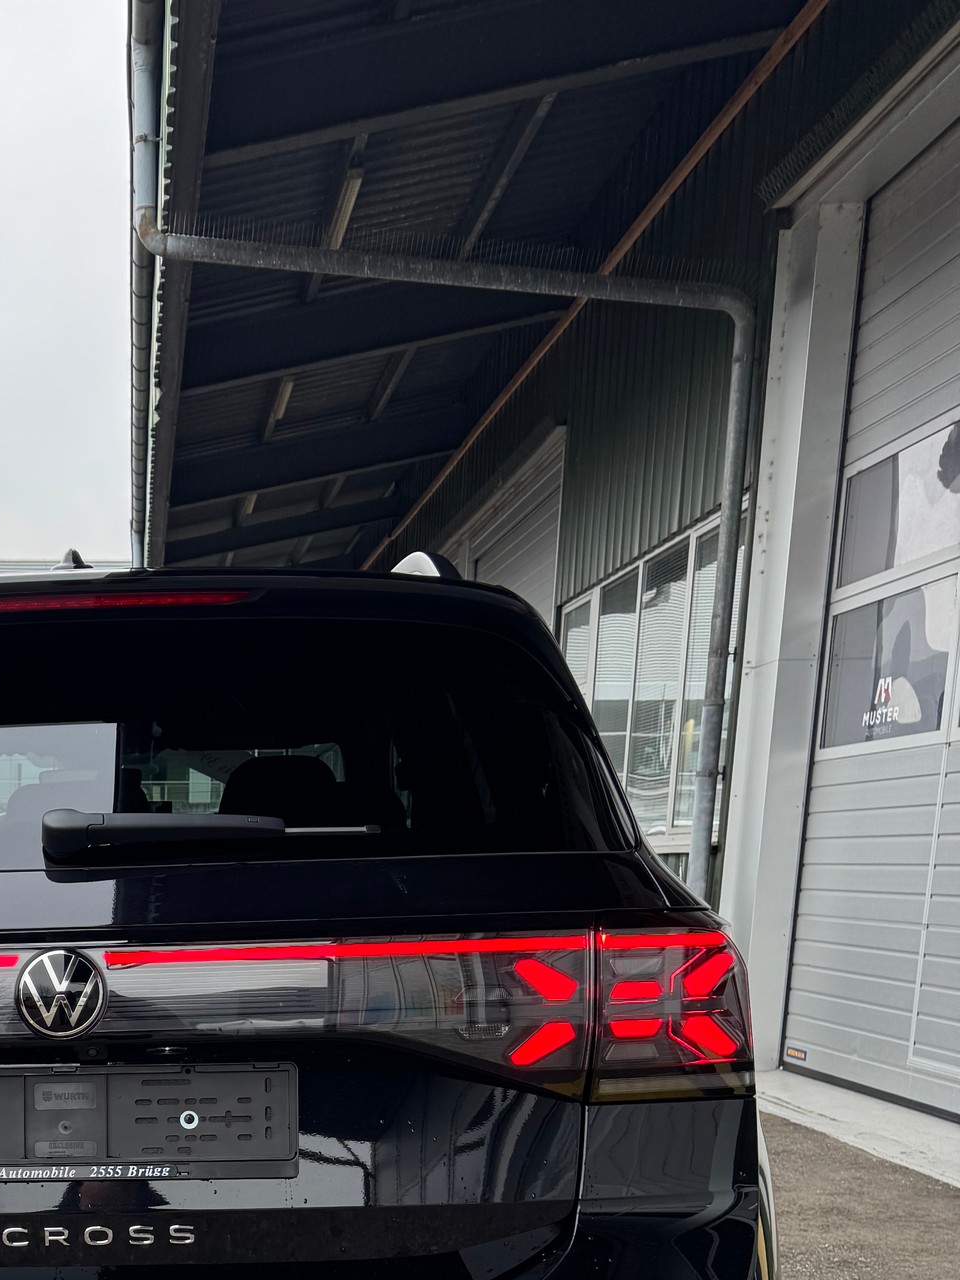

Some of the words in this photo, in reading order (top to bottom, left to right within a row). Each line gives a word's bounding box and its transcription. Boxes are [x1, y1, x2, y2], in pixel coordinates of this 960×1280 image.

[863, 707, 899, 726] MUSTER
[89, 1165, 123, 1178] 2555
[127, 1164, 171, 1178] Brügg
